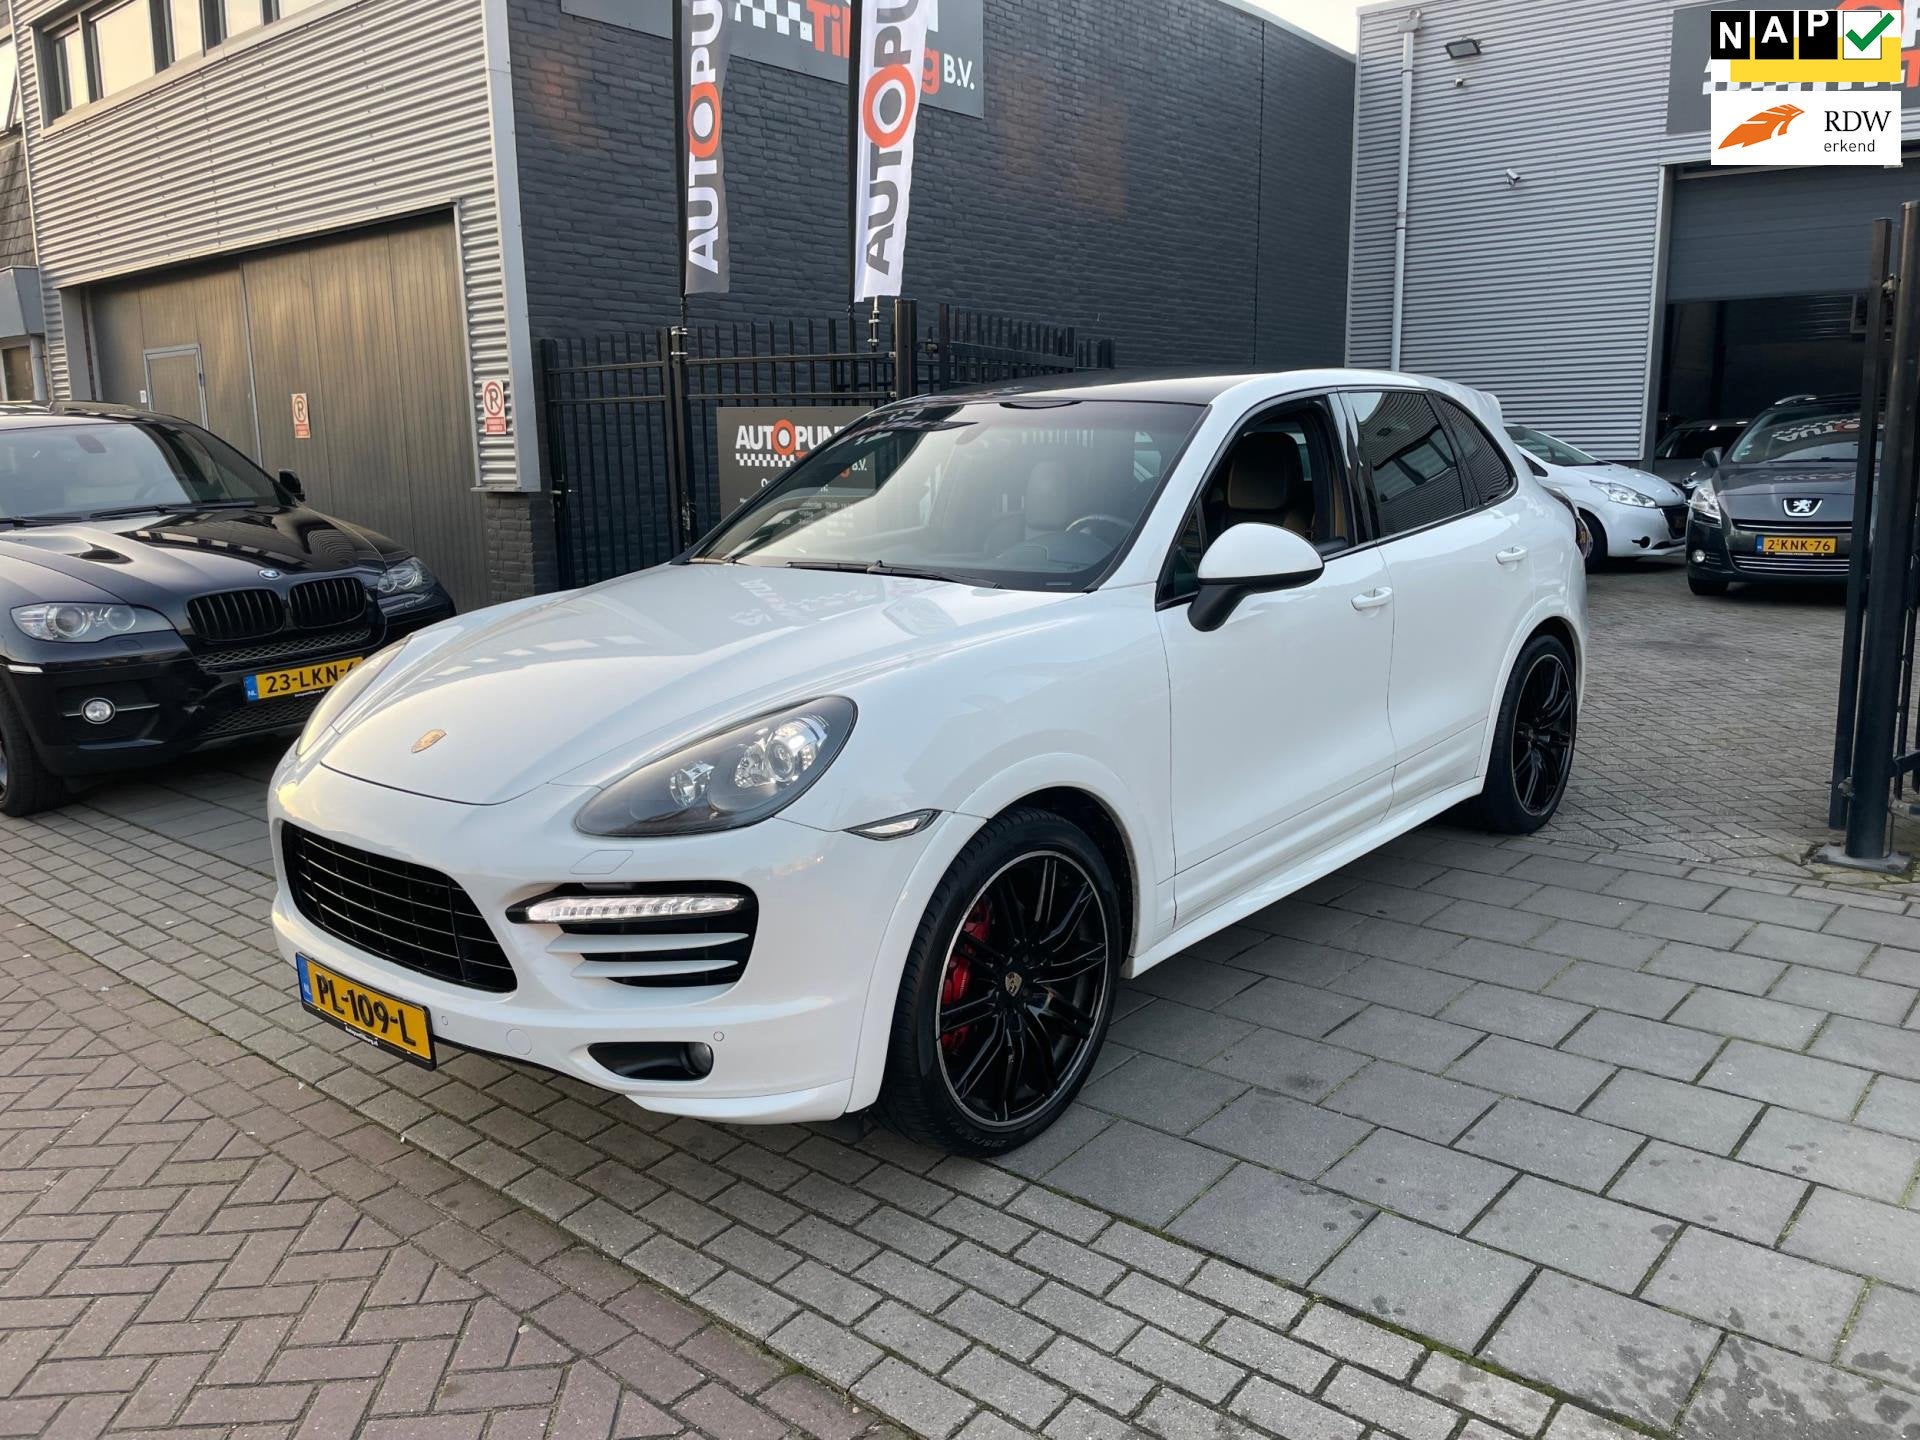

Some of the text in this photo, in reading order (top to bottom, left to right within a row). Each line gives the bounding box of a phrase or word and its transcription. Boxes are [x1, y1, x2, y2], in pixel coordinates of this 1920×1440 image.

[943, 53, 976, 91] B.V.
[735, 419, 846, 457] AUTOPUN
[315, 973, 417, 1047] PL-109-L
